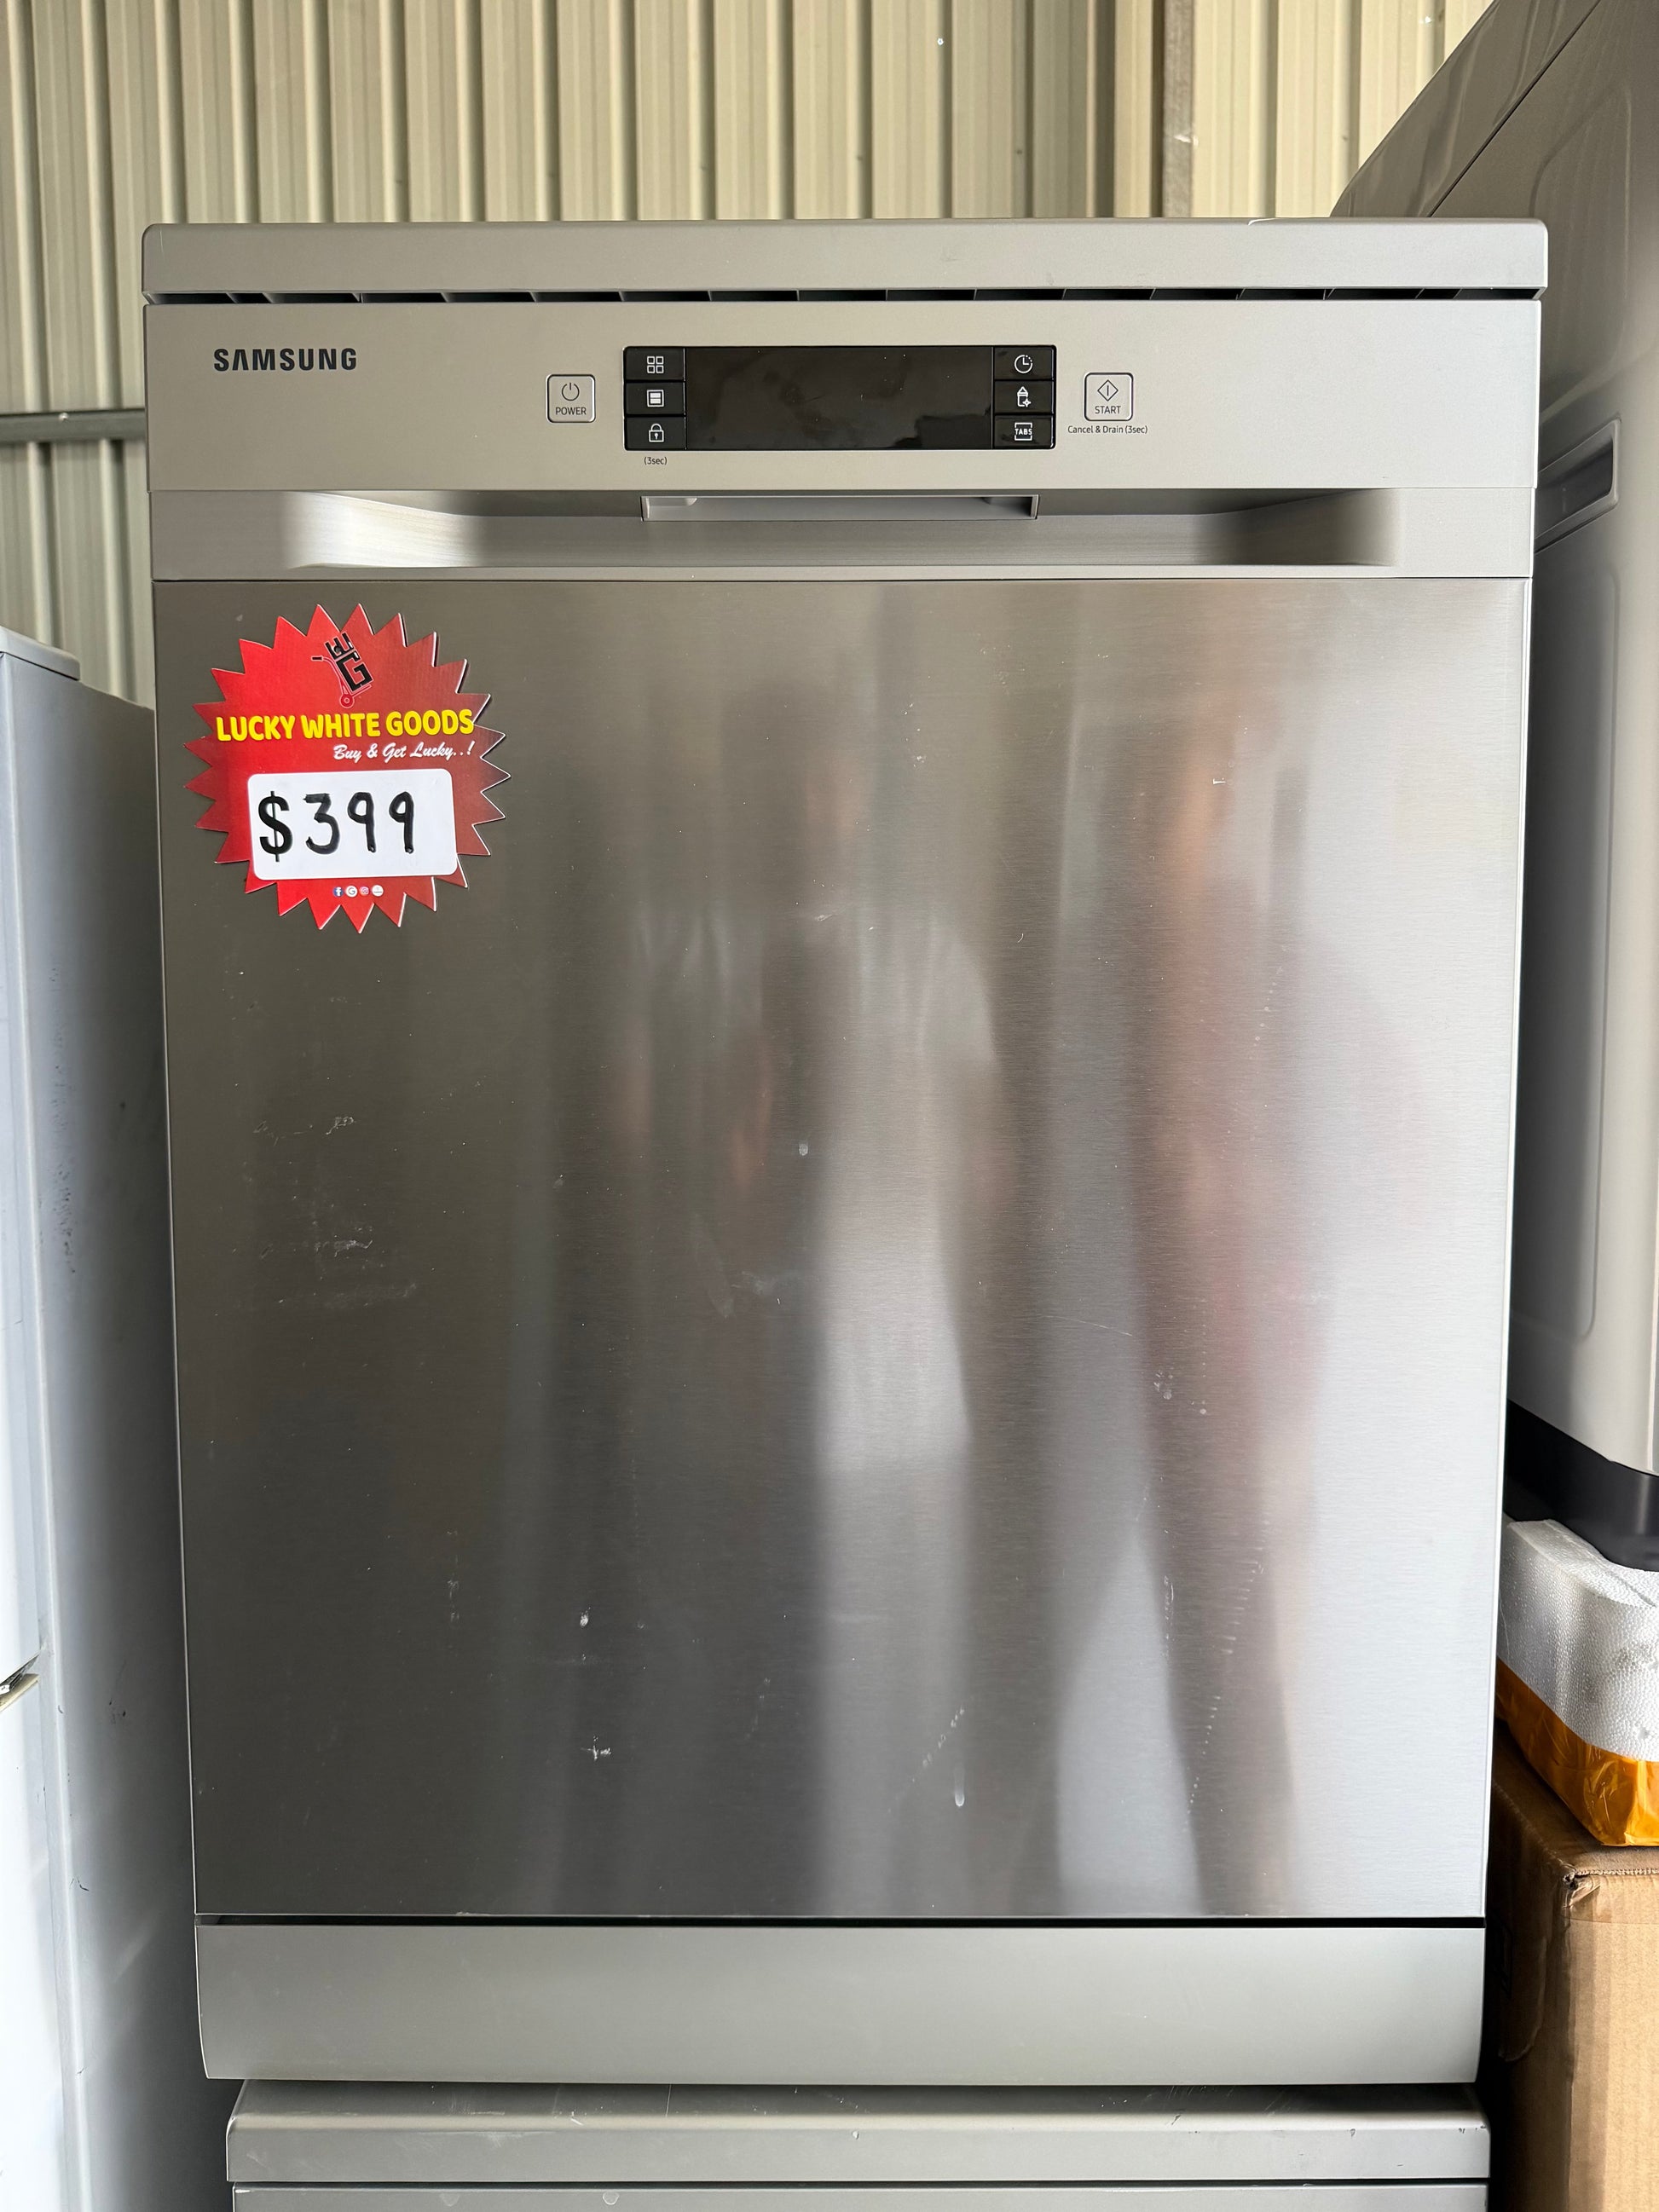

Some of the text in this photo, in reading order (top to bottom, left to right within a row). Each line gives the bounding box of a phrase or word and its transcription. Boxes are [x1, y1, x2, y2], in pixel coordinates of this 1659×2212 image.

[213, 348, 357, 372] SAMSUNG
[555, 407, 587, 416] POWER
[1095, 405, 1121, 414] START
[1067, 425, 1094, 434] Cancel
[1102, 425, 1124, 434] Drain
[1124, 425, 1147, 435] (3sec)
[644, 456, 668, 466] (3sec)
[216, 708, 475, 742] LUCKY WHITE GOODS
[333, 743, 362, 764] Buy
[366, 742, 378, 759] &
[382, 742, 408, 764] Get
[257, 790, 415, 863] $399
